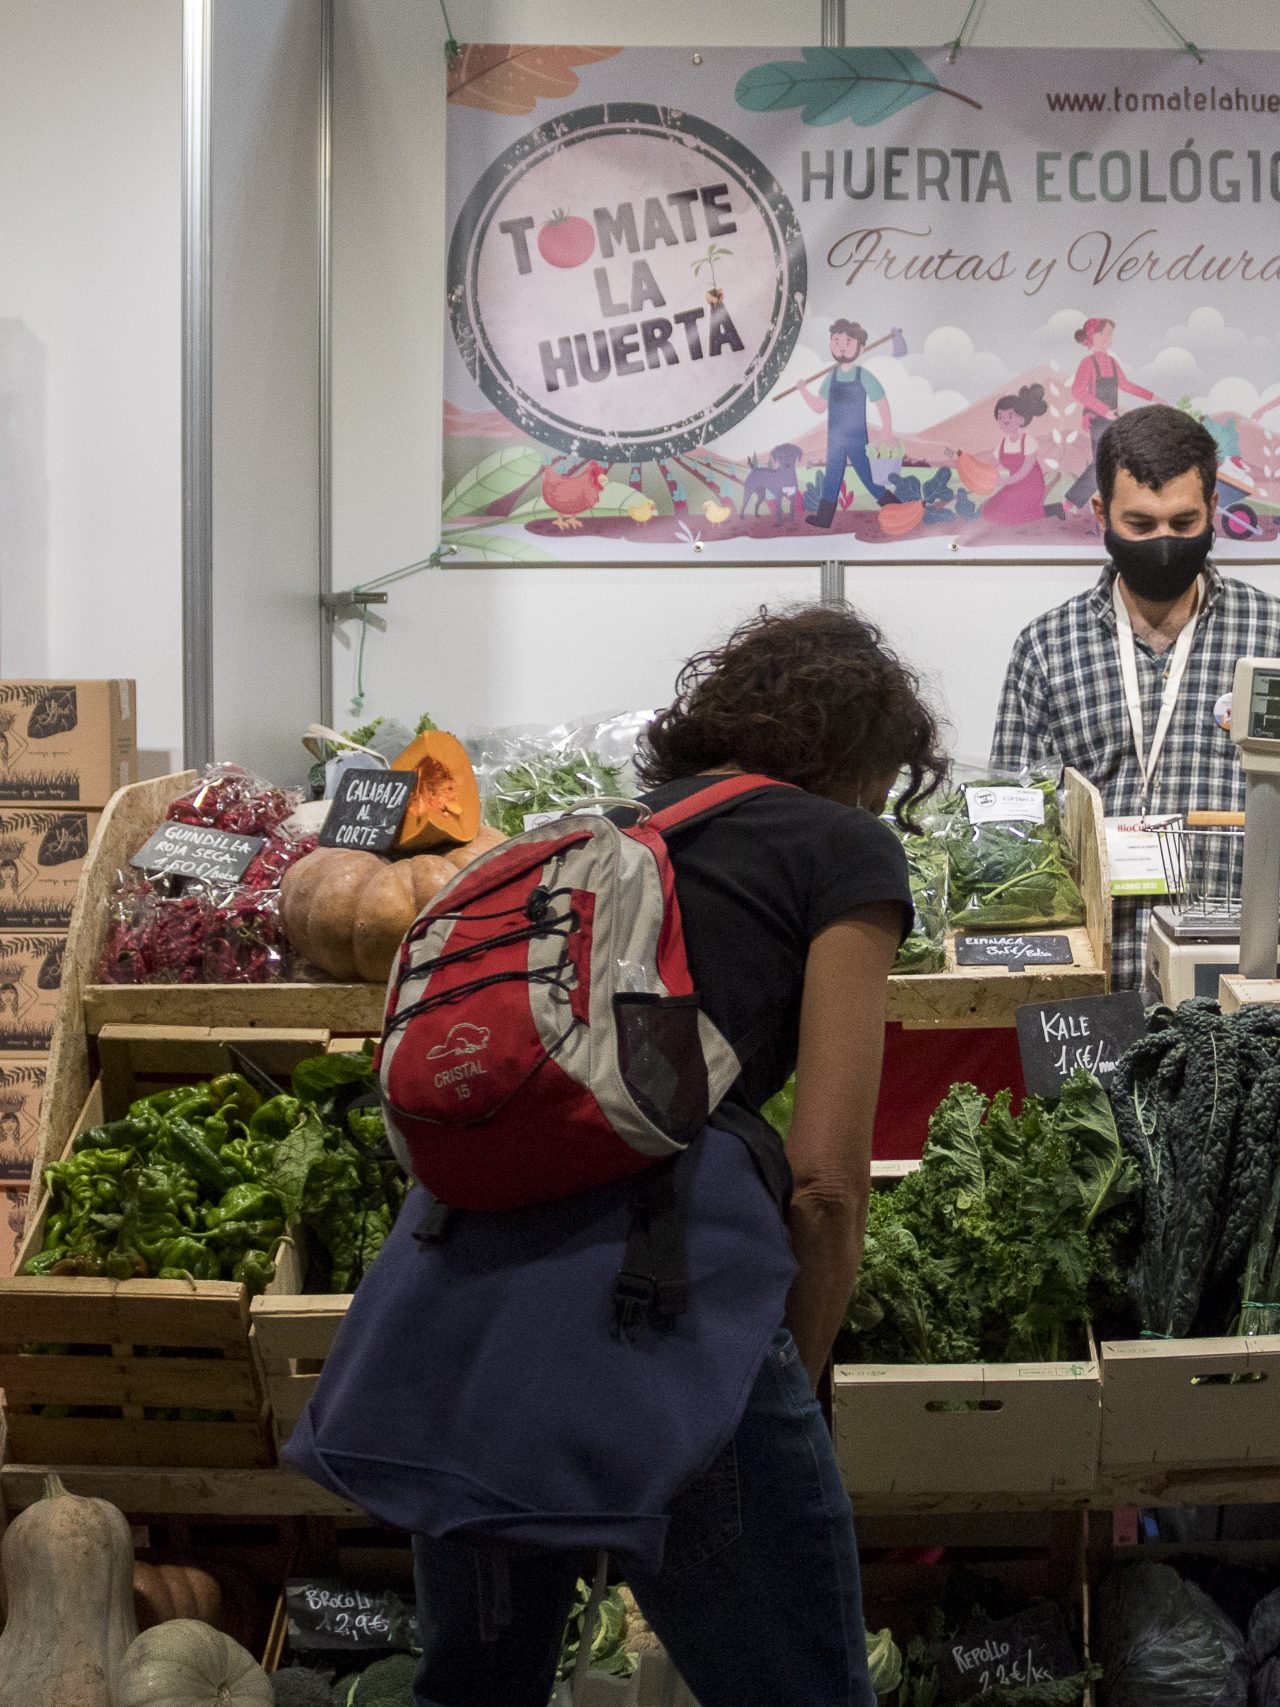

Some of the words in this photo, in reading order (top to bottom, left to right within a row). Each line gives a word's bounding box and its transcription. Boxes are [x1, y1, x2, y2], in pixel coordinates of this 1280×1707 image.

[802, 146, 1012, 204] HUERTA
[499, 182, 738, 275] TOMATE
[827, 226, 1014, 286] Frutas
[1021, 254, 1058, 296] y
[593, 259, 668, 319] LA
[537, 301, 745, 393] HUERTA
[346, 779, 408, 809] CALABAZA
[356, 804, 371, 820] AL
[335, 825, 379, 846] CORTE
[191, 848, 237, 863] SECA
[1040, 1010, 1091, 1042] KALE
[433, 1060, 487, 1089] CRISTAL
[455, 1084, 470, 1099] 15
[952, 1639, 1010, 1674] REPOLLO
